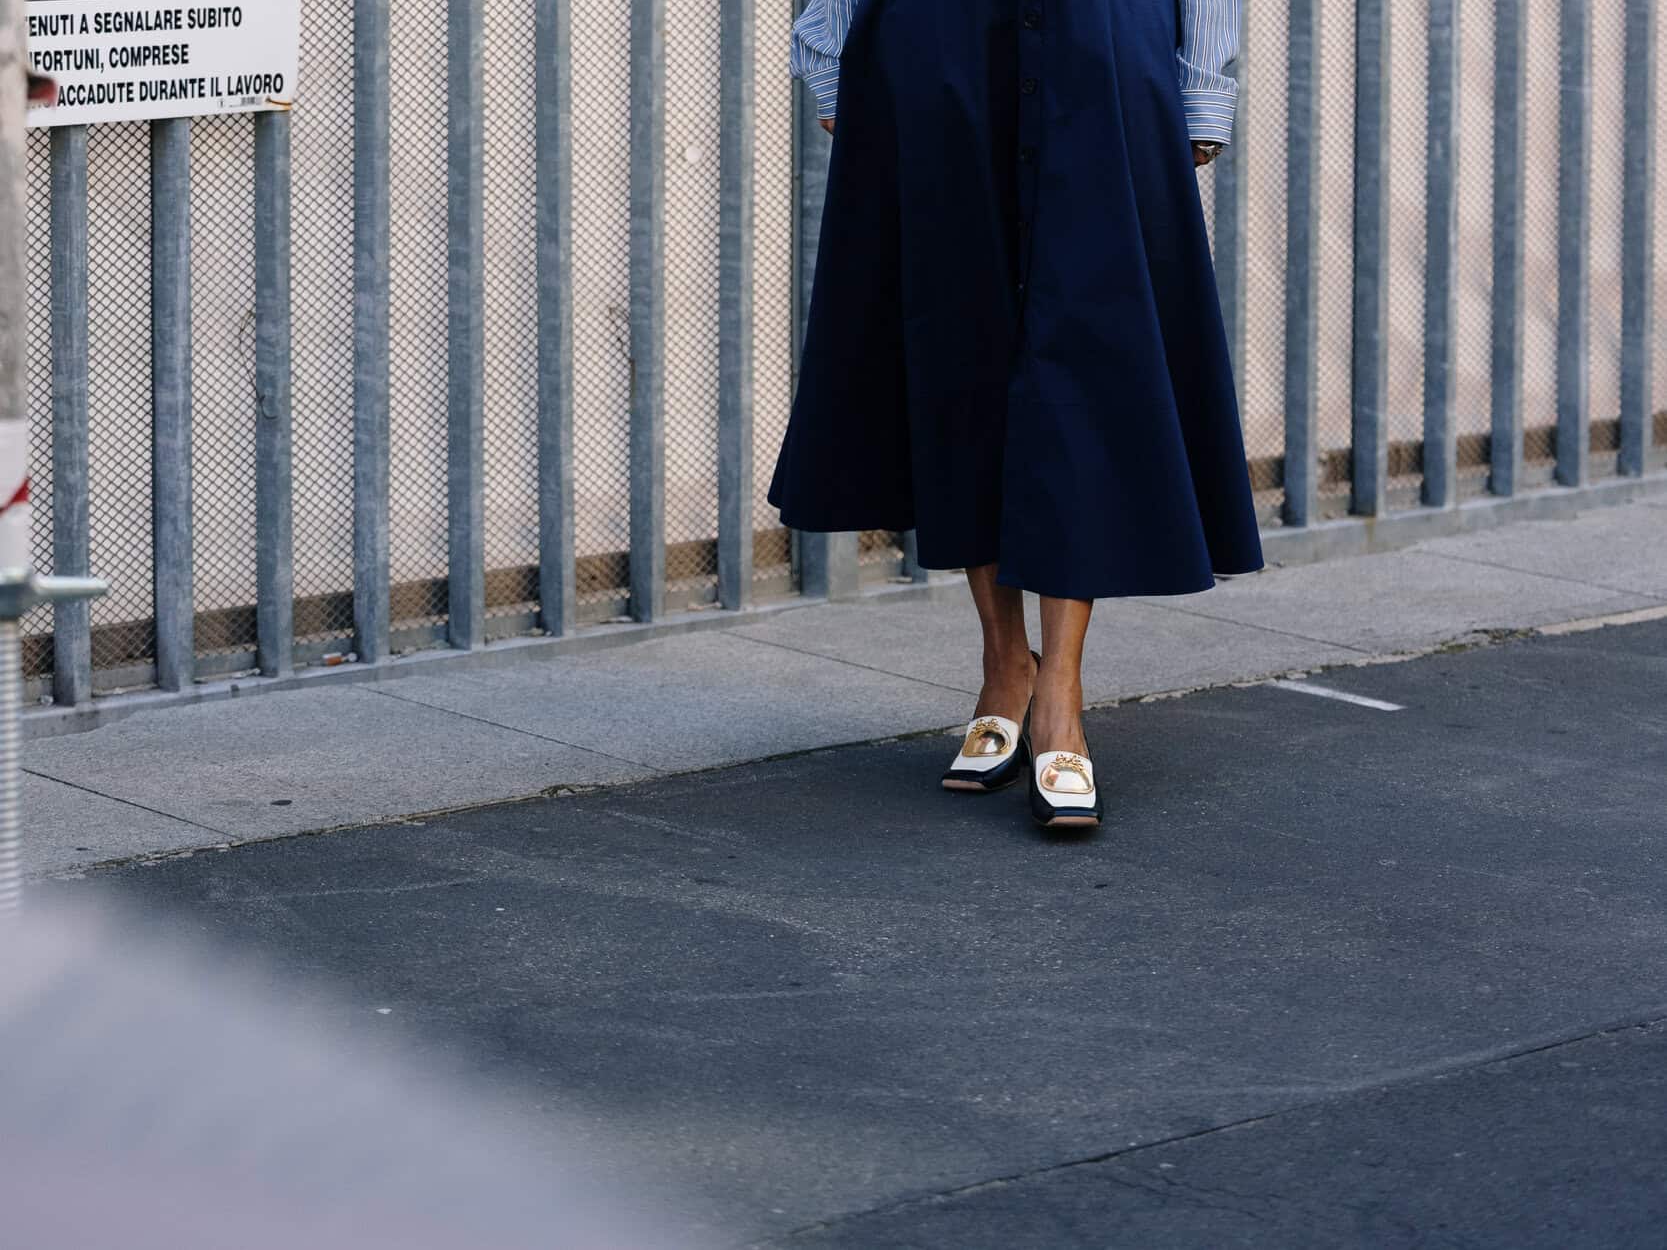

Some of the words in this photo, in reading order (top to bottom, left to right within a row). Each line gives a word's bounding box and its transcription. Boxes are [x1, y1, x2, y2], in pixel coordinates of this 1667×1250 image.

[80, 14, 89, 34] A
[94, 9, 182, 34] SEGNALARE
[188, 6, 242, 29] SUBITO
[109, 44, 189, 68] COMPRESE
[58, 82, 134, 107] ACCADUTE
[139, 78, 205, 102] DURANTE
[211, 77, 222, 97] IL
[227, 73, 283, 98] LAVORO
